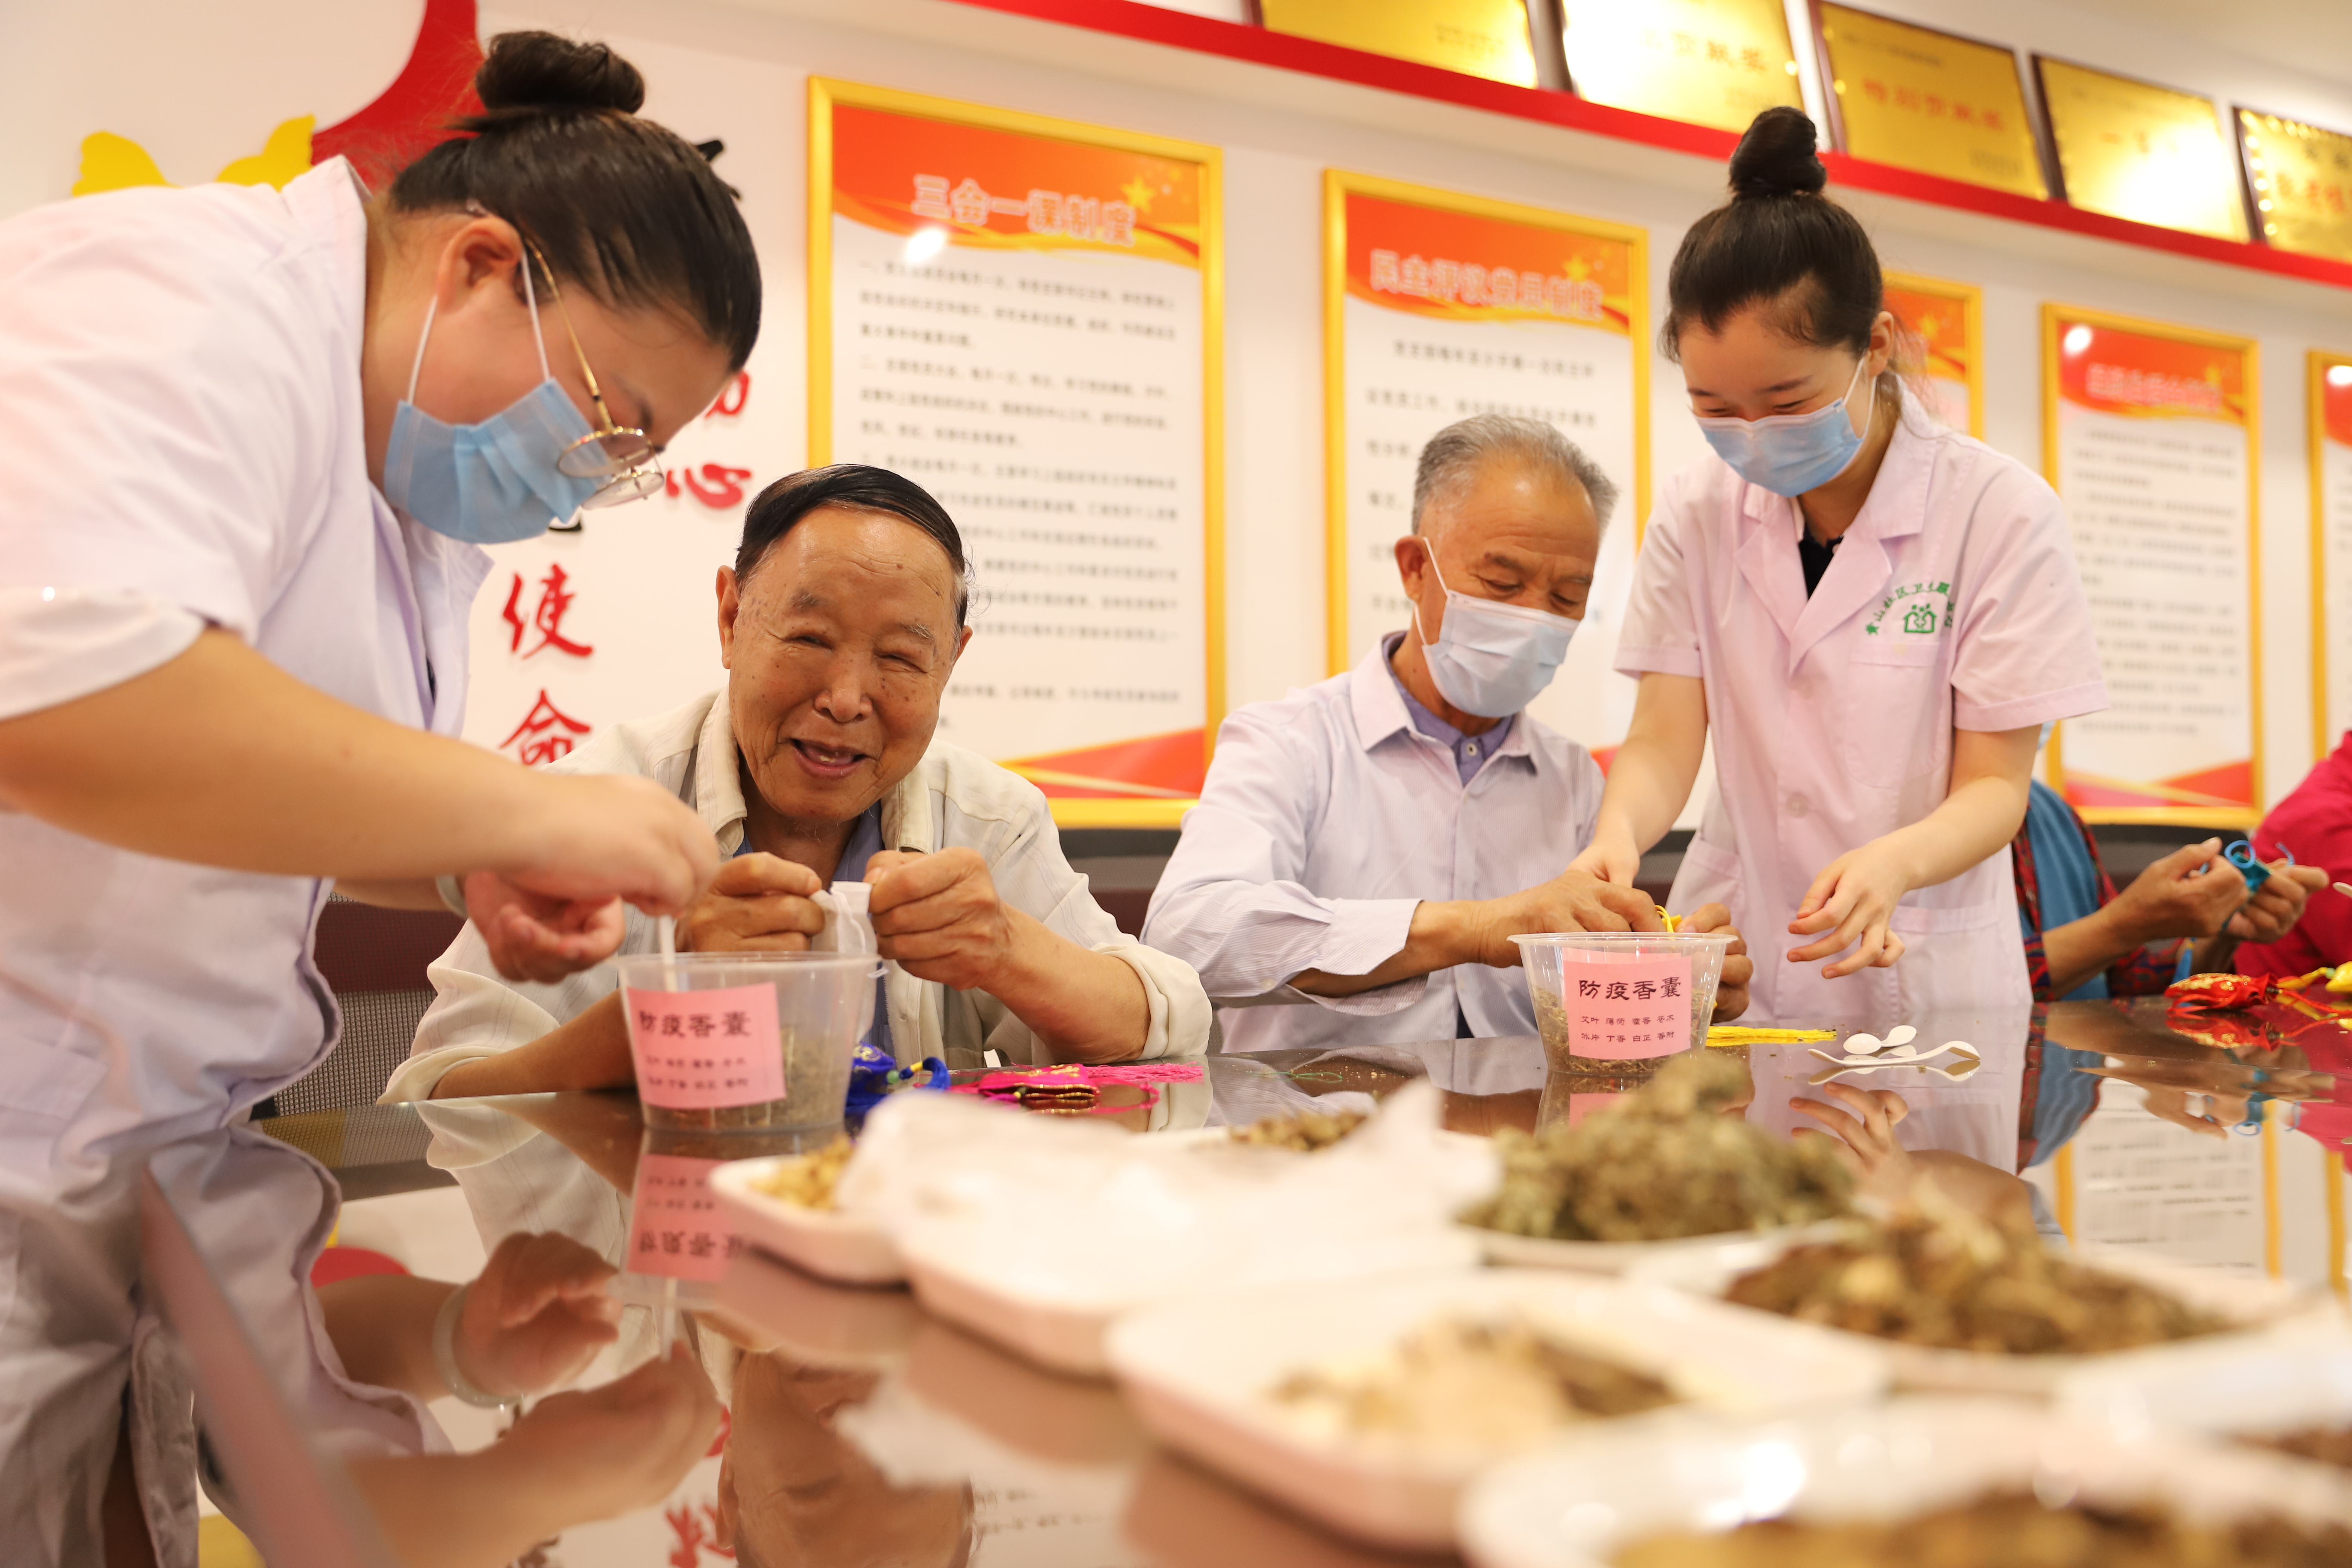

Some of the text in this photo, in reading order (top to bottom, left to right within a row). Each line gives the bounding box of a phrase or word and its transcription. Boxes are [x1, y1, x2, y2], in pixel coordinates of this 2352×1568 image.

[912, 173, 1135, 247] 三会一课制度
[500, 513, 593, 765] 使命
[1579, 977, 1681, 1000] 防疫香囊
[639, 1010, 750, 1038] 防疫香囊
[1605, 1017, 1625, 1026] 薄荷
[1581, 1033, 1599, 1041] 冰片
[1657, 1032, 1674, 1040] 香附
